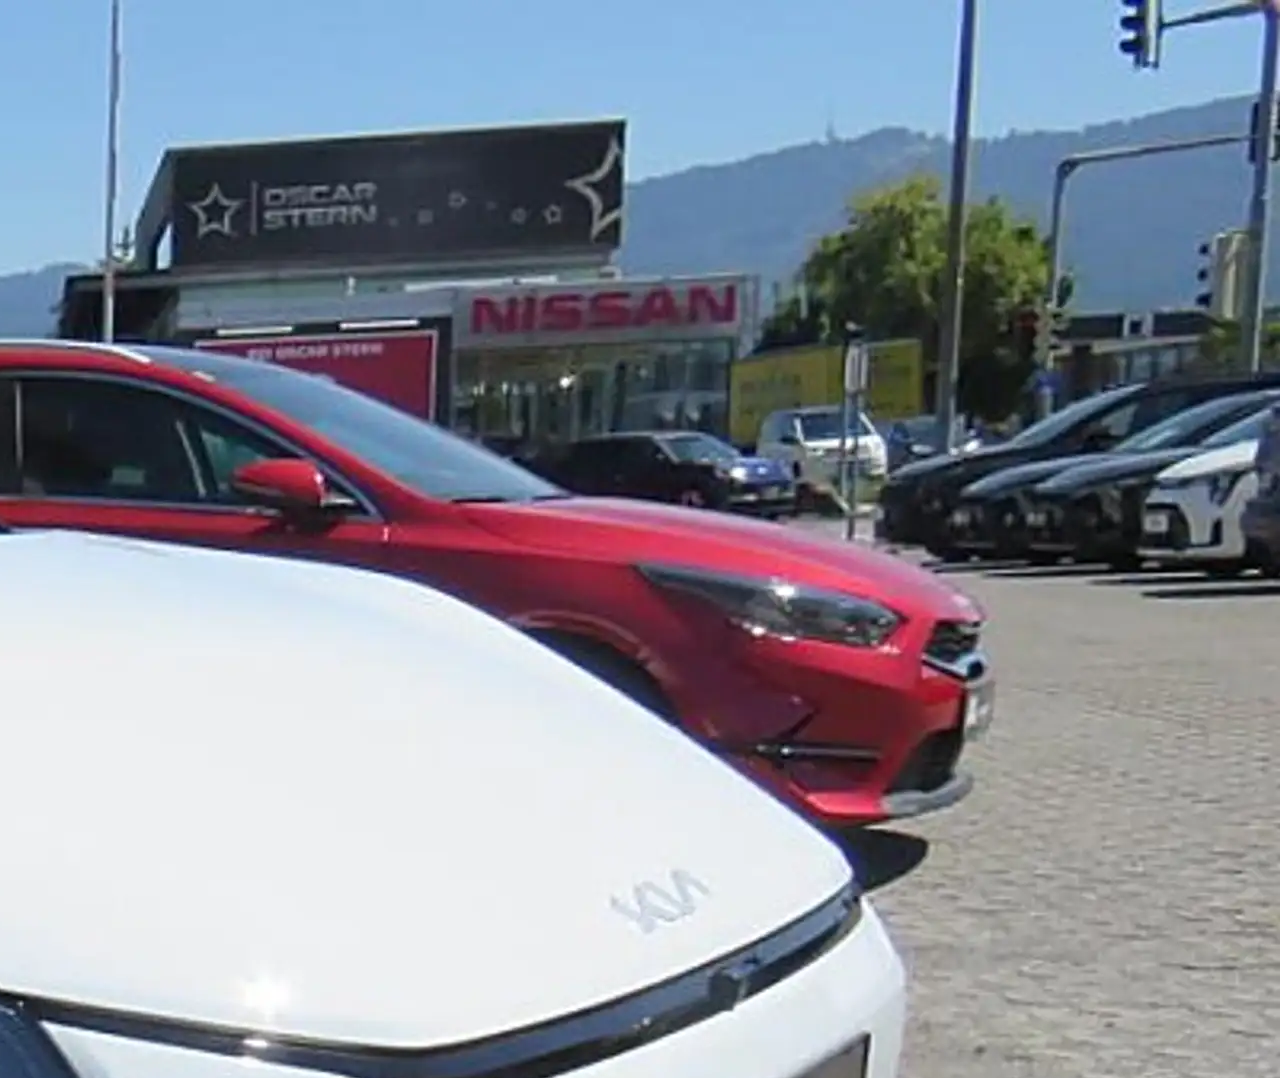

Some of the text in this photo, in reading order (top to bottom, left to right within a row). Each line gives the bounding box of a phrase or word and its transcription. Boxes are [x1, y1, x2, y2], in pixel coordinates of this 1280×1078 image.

[263, 182, 377, 206] OSCAR
[262, 204, 377, 228] STERN
[471, 284, 736, 334] NISSAN
